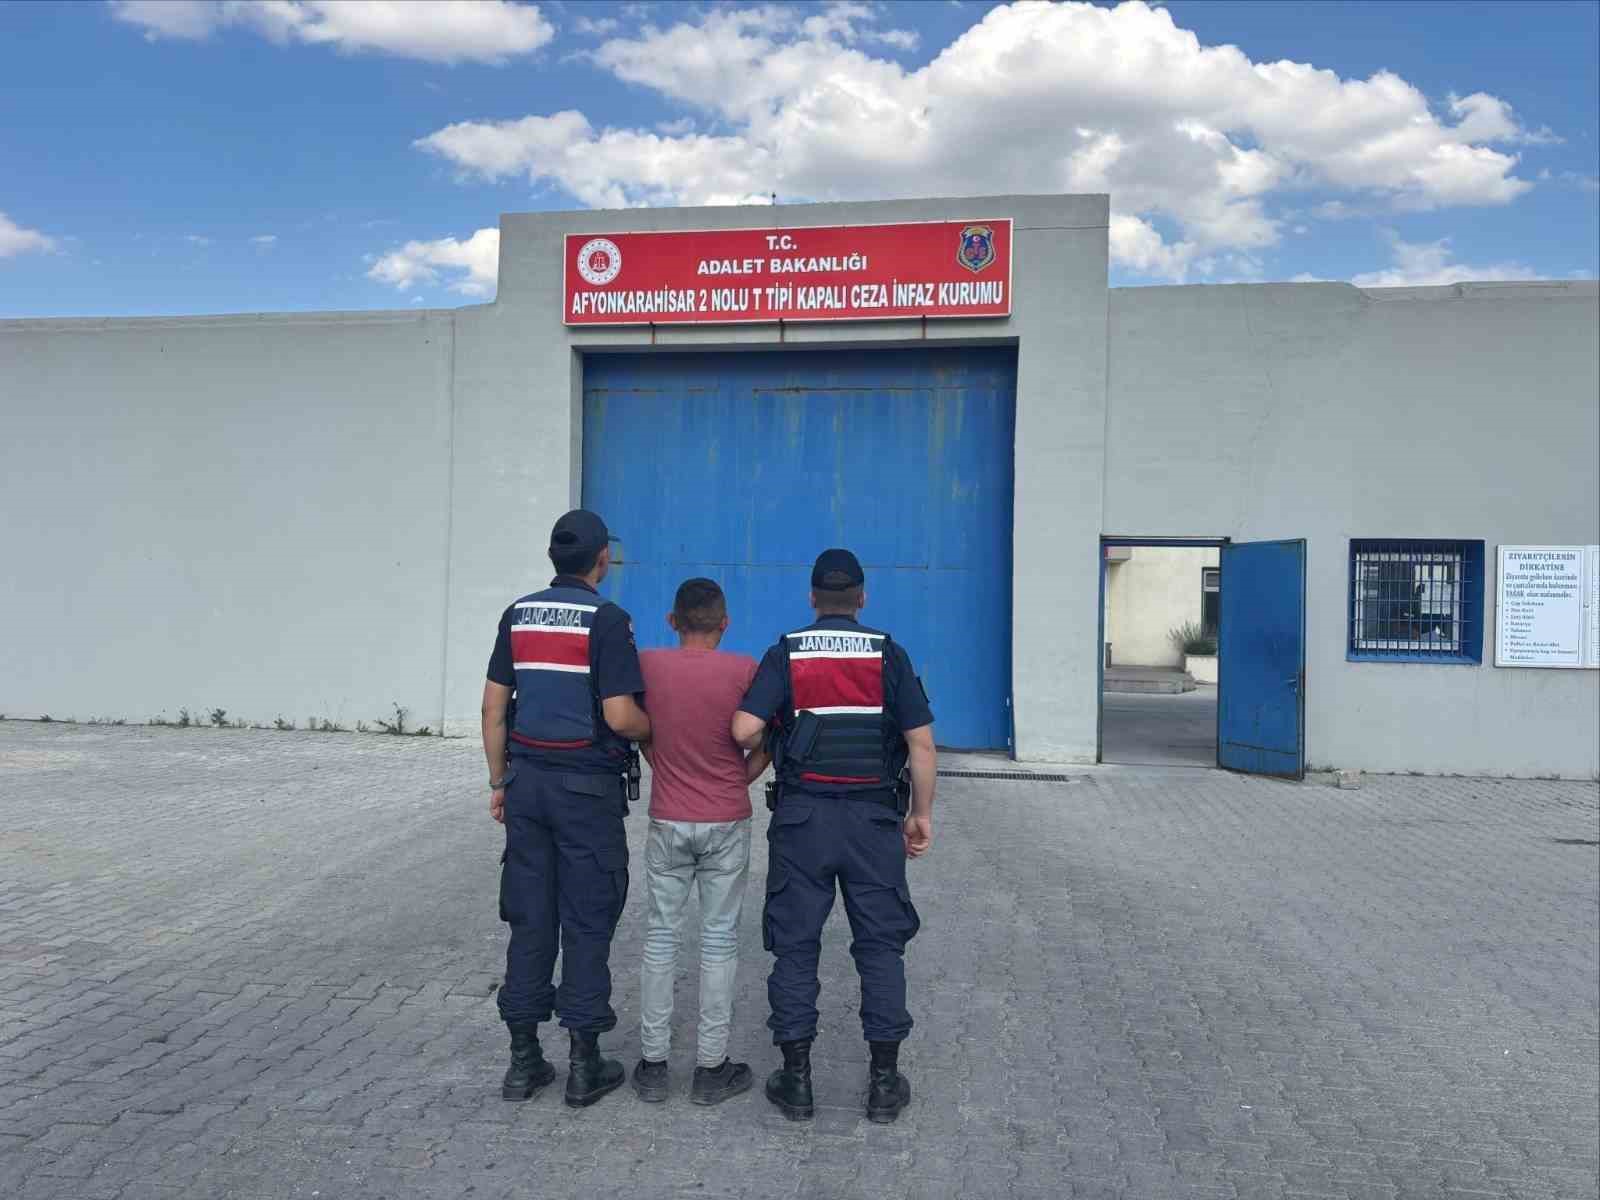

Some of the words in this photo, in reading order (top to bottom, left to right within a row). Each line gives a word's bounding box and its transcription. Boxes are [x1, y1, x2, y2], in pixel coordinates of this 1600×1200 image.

[766, 235, 797, 250] T.C.
[697, 258, 765, 275] ADALET
[770, 252, 867, 273] BAKANLIĞI
[572, 283, 695, 314] AFYONKARAHİSAR
[699, 289, 708, 312] 2
[711, 287, 749, 311] NOLU
[753, 287, 762, 310] T
[766, 281, 793, 310] TİPİ
[797, 285, 847, 310] KAPALI
[851, 284, 889, 309] CEZA
[893, 278, 935, 307] İNFAZ
[938, 280, 1004, 306] KURUMU
[519, 607, 582, 627] JANDARMA
[799, 636, 874, 653] JANDARMA
